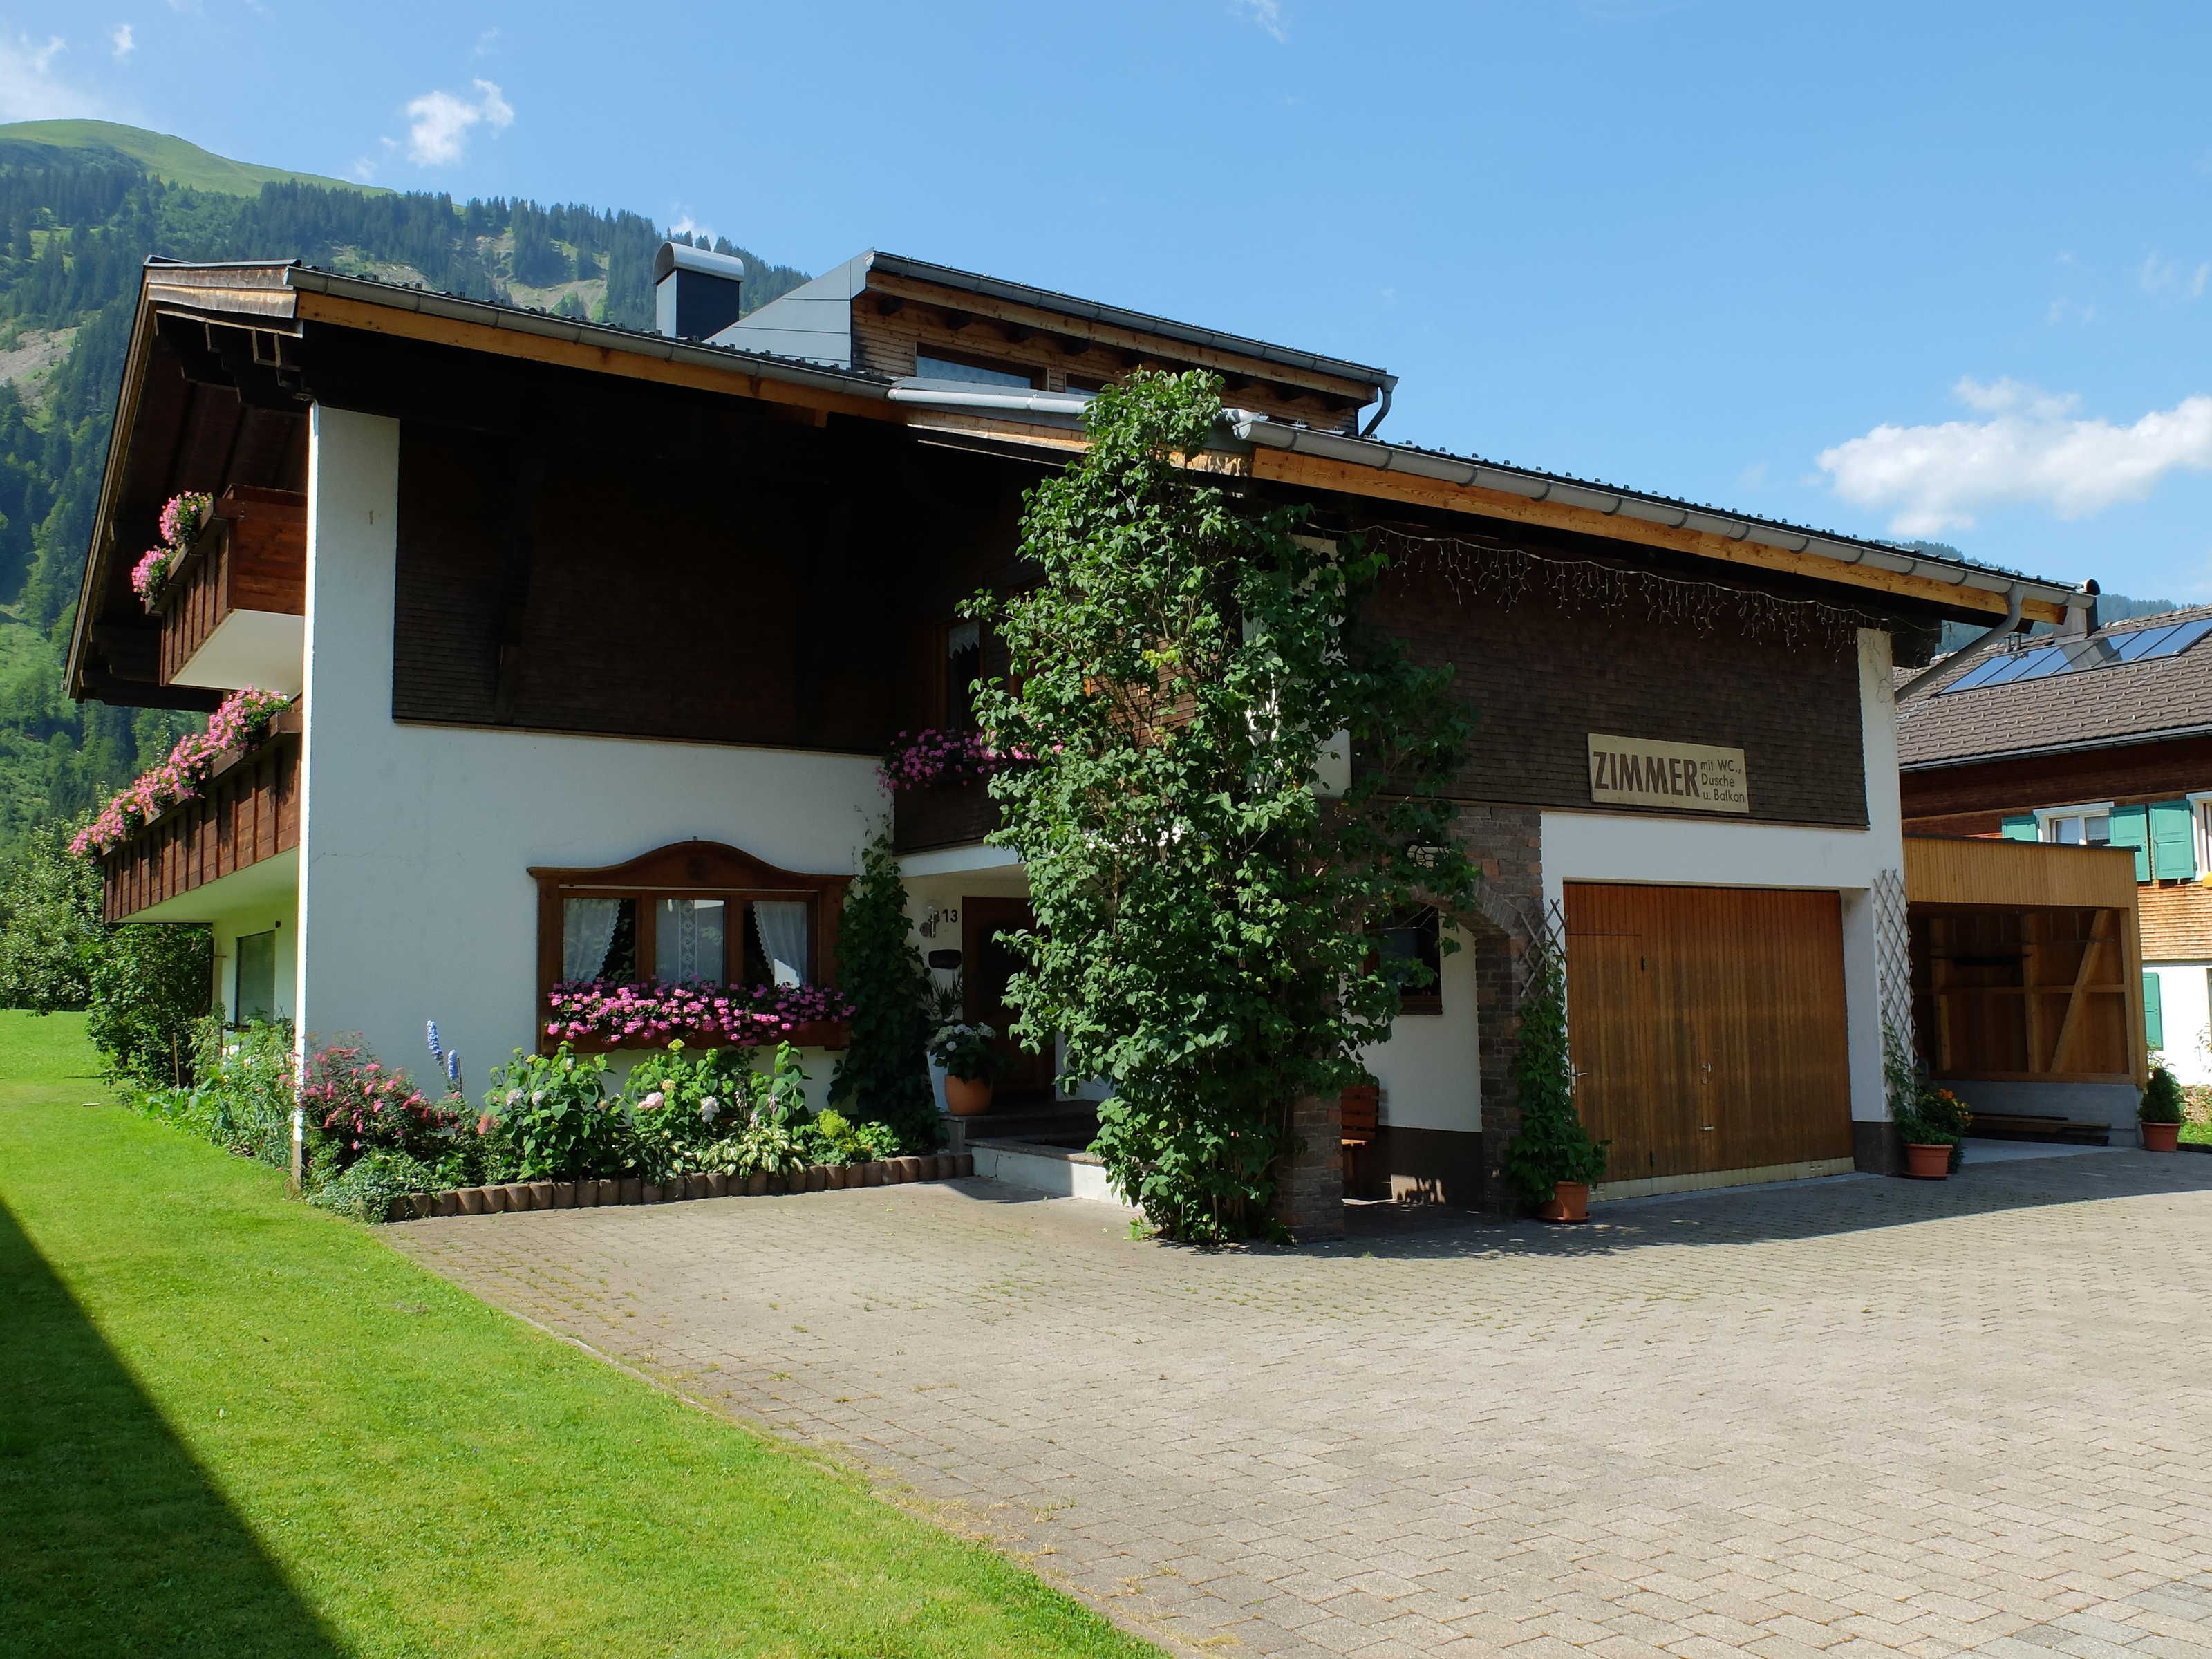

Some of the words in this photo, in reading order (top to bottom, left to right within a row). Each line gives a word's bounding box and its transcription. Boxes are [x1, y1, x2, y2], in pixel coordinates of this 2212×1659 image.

[1700, 760, 1714, 772] mit
[1593, 751, 1700, 797] ZIMMER
[1701, 773, 1735, 788] Dusche
[1703, 792, 1712, 800] u.
[1714, 788, 1745, 803] Balkon
[941, 908, 958, 923] 13
